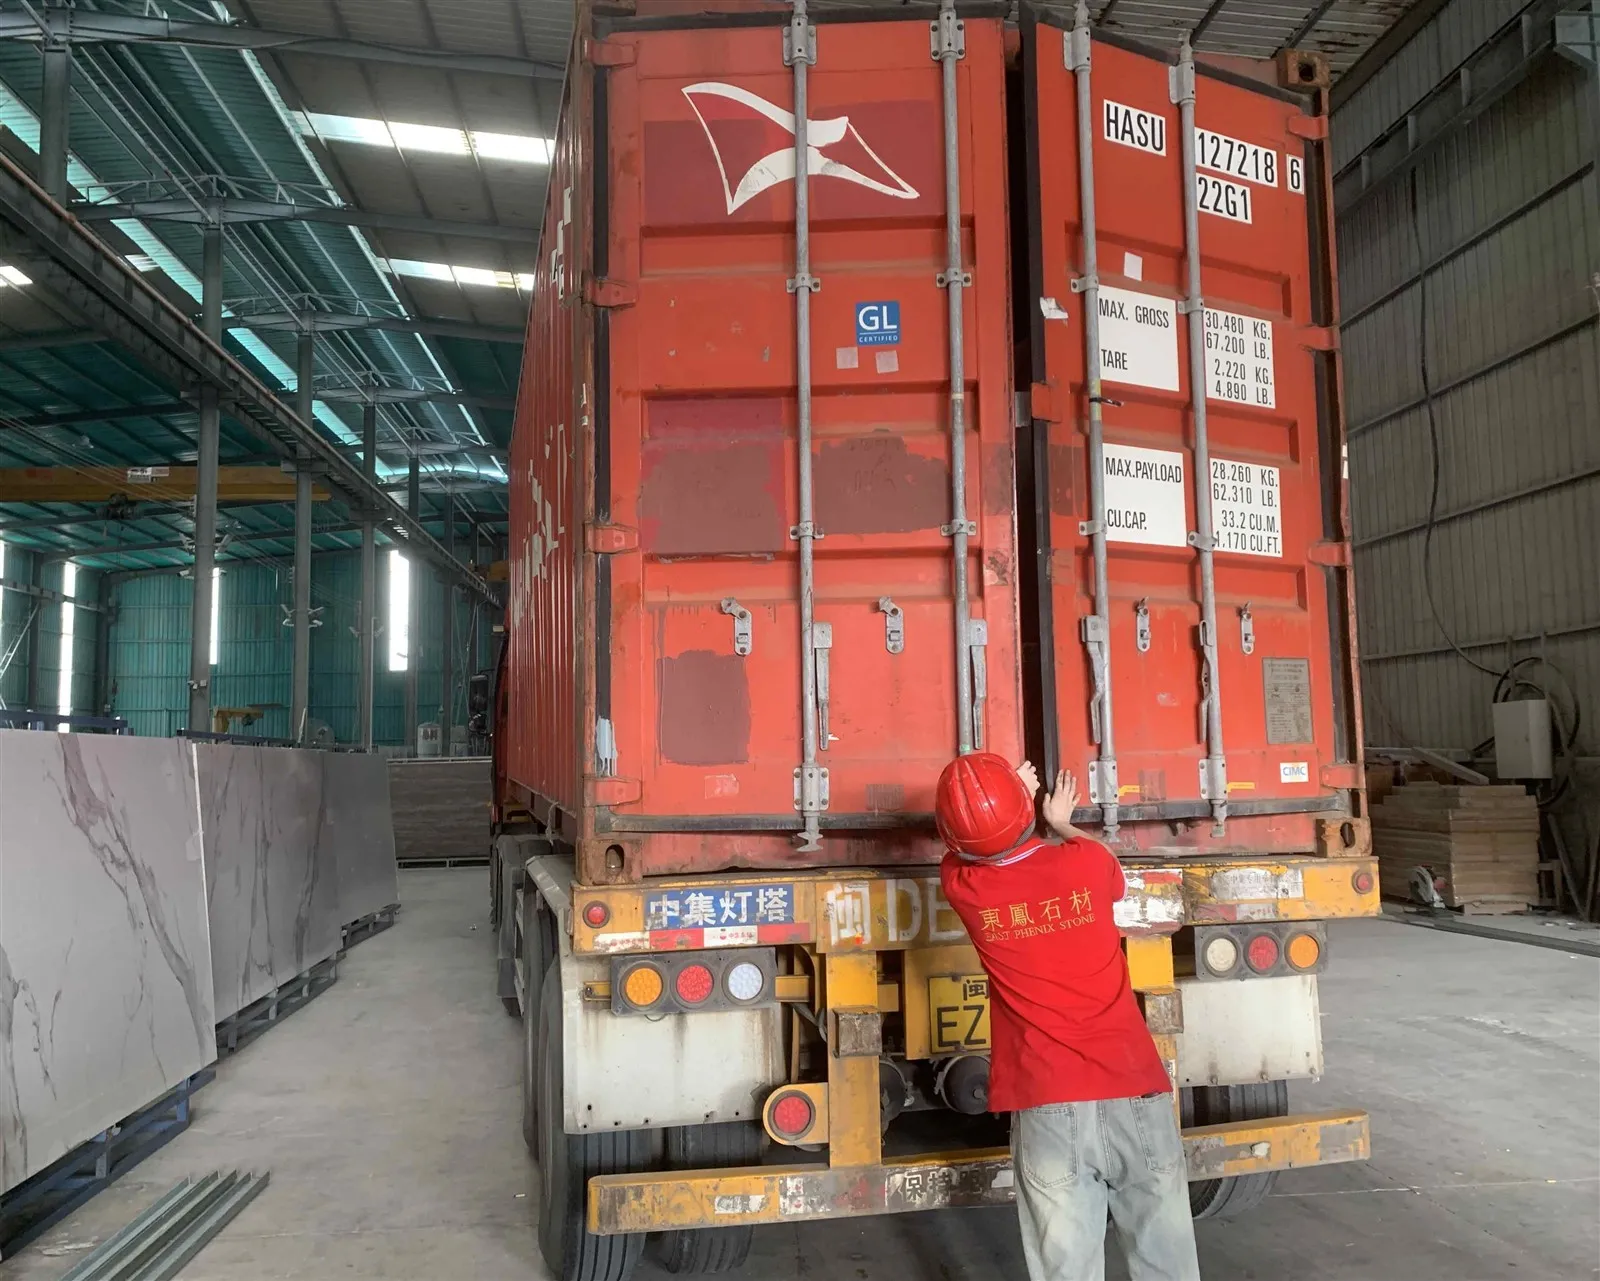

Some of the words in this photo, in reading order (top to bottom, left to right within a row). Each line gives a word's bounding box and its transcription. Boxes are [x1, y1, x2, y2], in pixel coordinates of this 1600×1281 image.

[1106, 103, 1164, 152] HASU
[1198, 132, 1275, 184] 127218
[1290, 158, 1301, 190] 6
[1198, 177, 1249, 220] 22G1
[858, 305, 897, 330] GL
[1099, 297, 1129, 321] MAX.
[1135, 305, 1170, 329] GROSS
[1253, 321, 1271, 341] KG.
[1254, 342, 1270, 360] LB.
[1101, 349, 1128, 370] TARE
[1255, 366, 1273, 386] KG.
[1256, 387, 1272, 406] LB.
[1105, 457, 1182, 483] MAX.PAYLOAD
[1260, 469, 1278, 488] KG.
[1261, 490, 1277, 508] LB.
[1107, 509, 1147, 530] CU.CAP.
[1221, 510, 1246, 530] 33.2
[1249, 513, 1279, 534] CU.M.
[1249, 534, 1281, 555] CU.FT.
[1282, 766, 1306, 777] CIMC
[648, 888, 788, 928] 中集灯塔
[978, 887, 1092, 931] 東鳳石材
[986, 930, 1010, 942] EAST
[1014, 924, 1055, 940] PHENIX
[1059, 913, 1096, 930] STONE
[962, 979, 990, 1001] 闽
[936, 1004, 987, 1048] EZ
